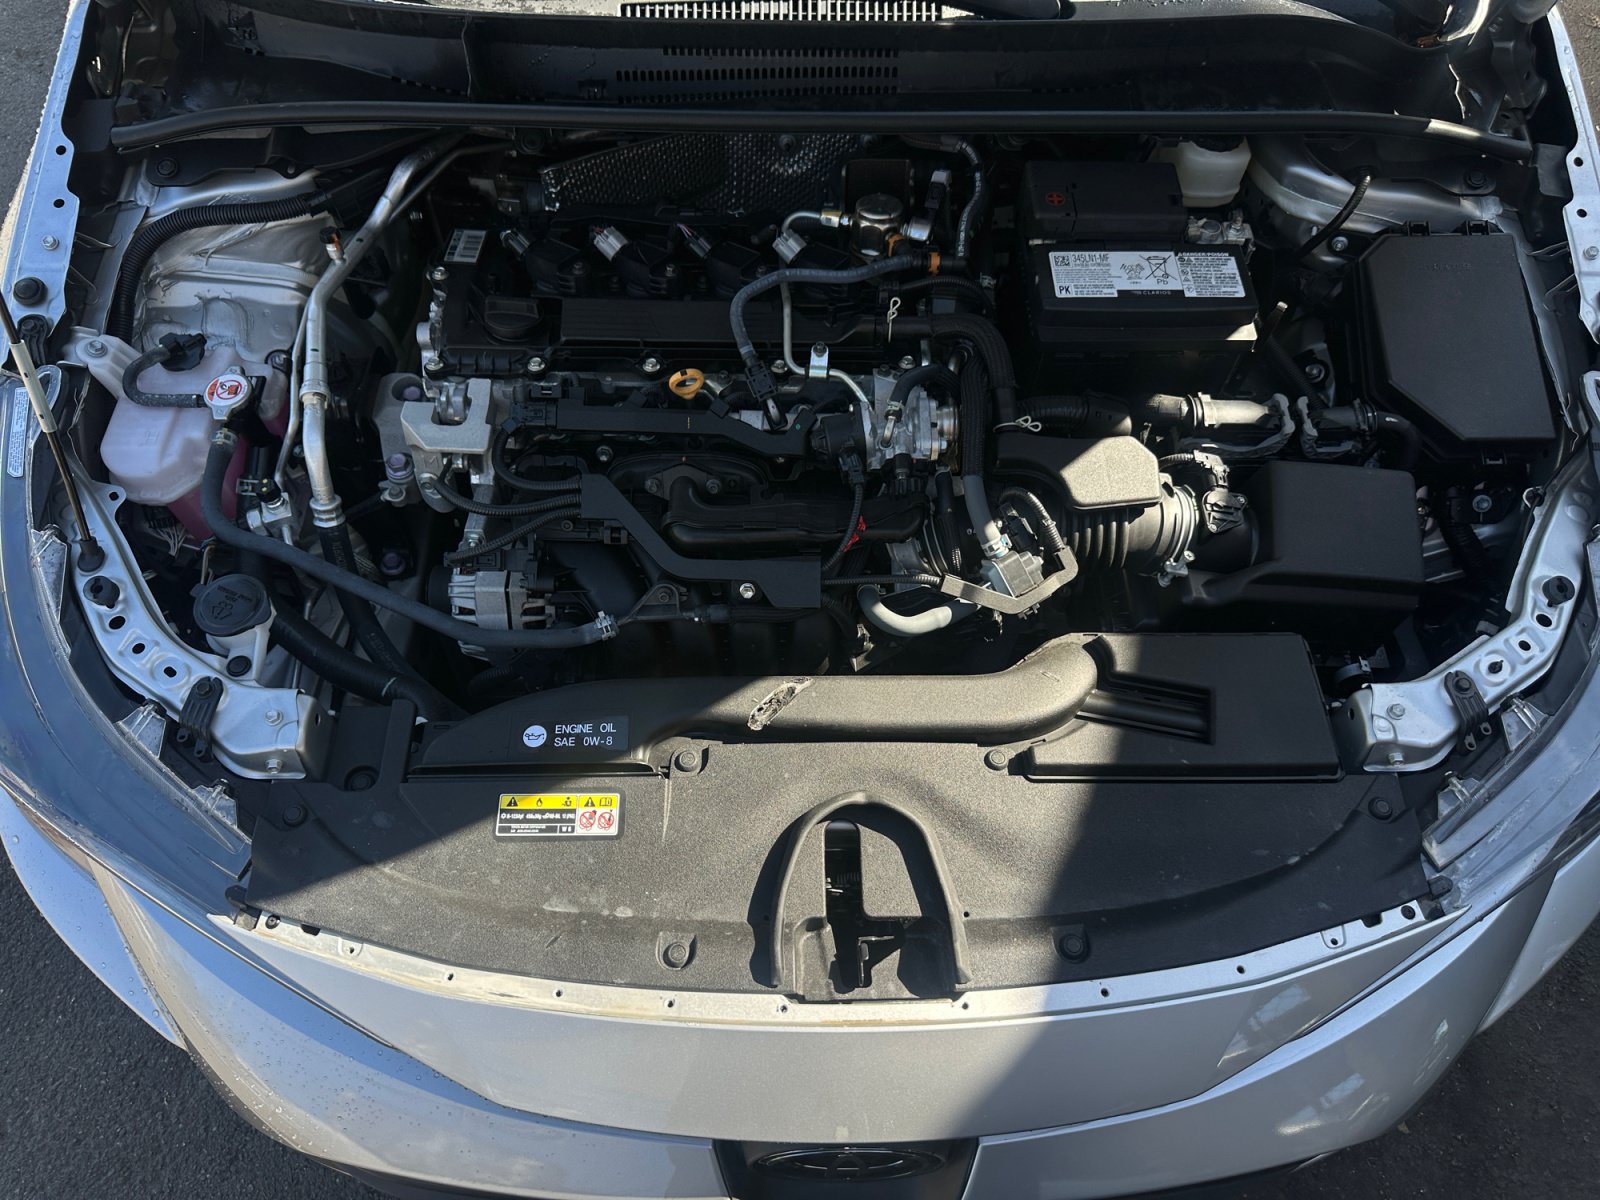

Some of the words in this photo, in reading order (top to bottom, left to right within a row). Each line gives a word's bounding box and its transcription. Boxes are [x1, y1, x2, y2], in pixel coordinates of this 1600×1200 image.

[1058, 285, 1072, 295] PK
[554, 724, 593, 734] ENGINE
[600, 722, 616, 733] OIL
[554, 736, 576, 747] SAE
[583, 736, 613, 746] 0W-8
